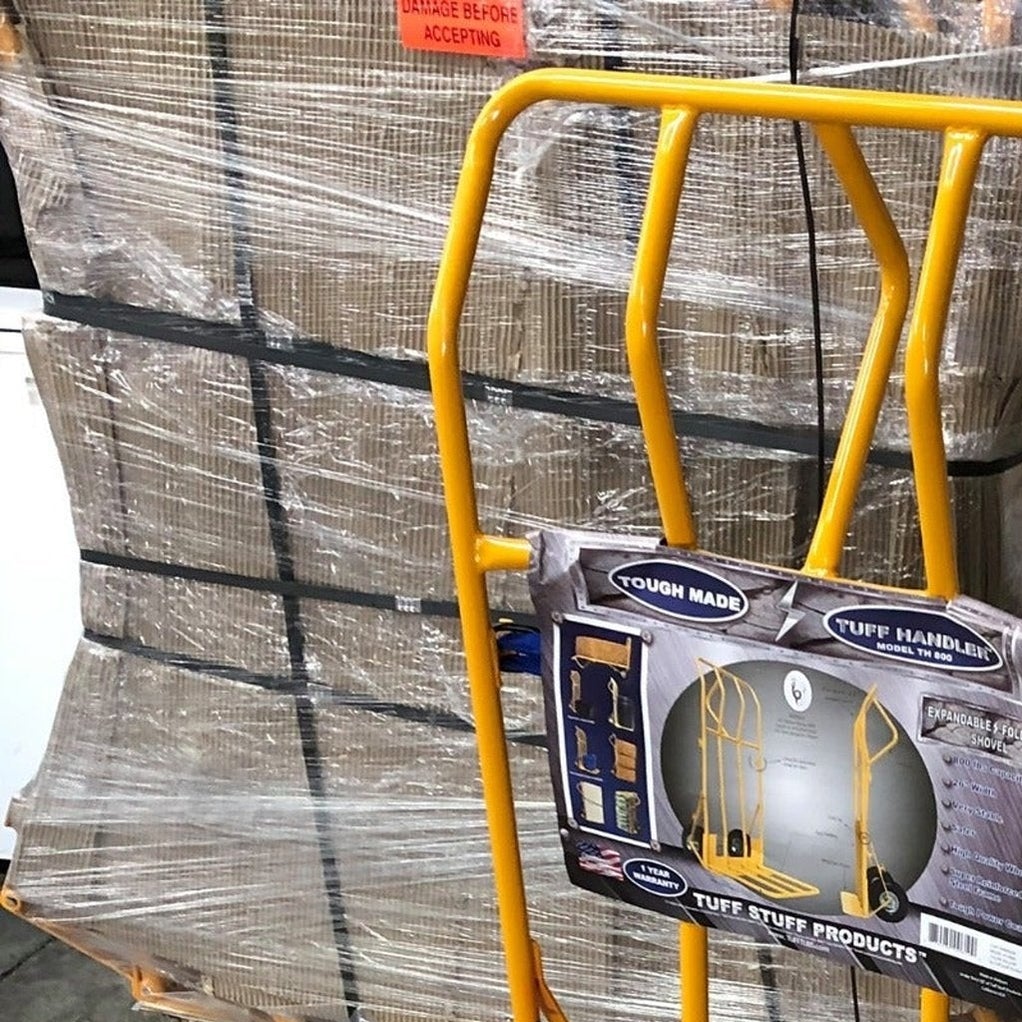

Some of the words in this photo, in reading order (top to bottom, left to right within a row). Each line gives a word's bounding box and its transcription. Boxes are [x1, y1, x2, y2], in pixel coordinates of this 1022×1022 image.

[402, 0, 459, 18] DAMAGE
[464, 3, 518, 23] BEFORE
[424, 25, 501, 48] ACCEPTING
[617, 576, 684, 599] TOUGH
[689, 587, 741, 611] MADE
[835, 618, 890, 639] TUFF
[896, 627, 991, 661] HANDLER
[876, 642, 914, 655] MODEL
[917, 648, 932, 658] TH
[928, 706, 992, 732] EXPANDABLE
[971, 734, 1008, 753] SHOVEL
[633, 871, 680, 890] WARRANTY
[647, 865, 671, 879] YEAR
[692, 892, 743, 915] TUFF
[748, 904, 808, 933] STUFF
